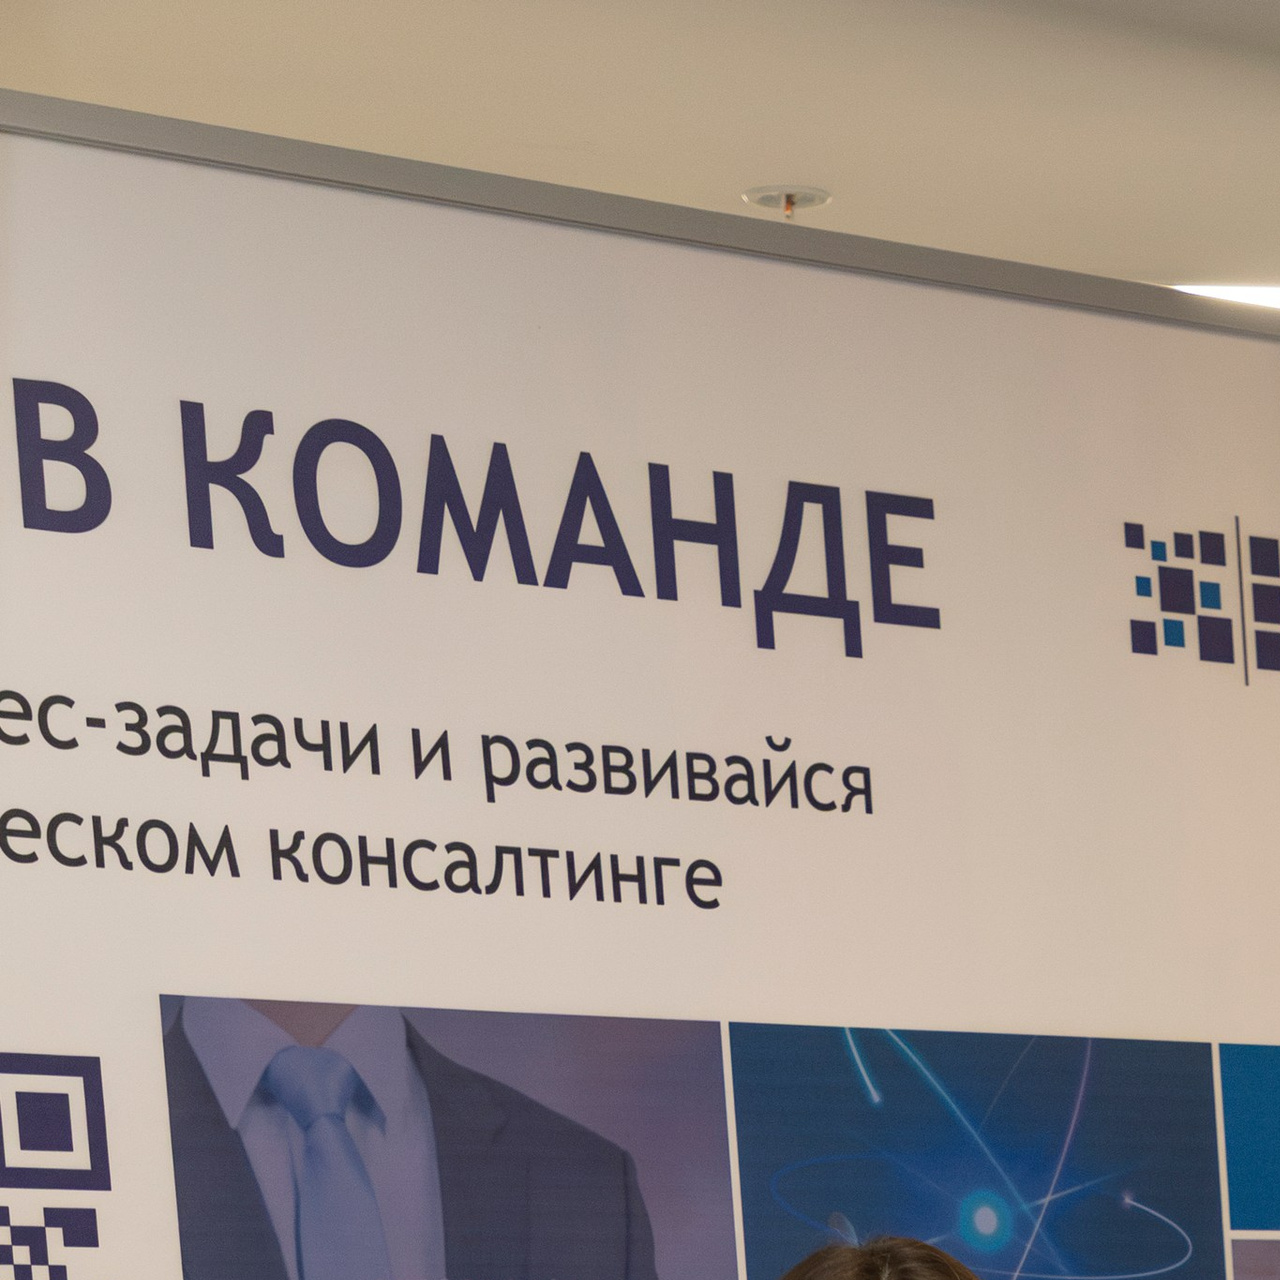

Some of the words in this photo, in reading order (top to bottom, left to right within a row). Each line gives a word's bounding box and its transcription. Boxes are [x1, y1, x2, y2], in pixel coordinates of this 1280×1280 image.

[12, 378, 112, 534] В
[180, 399, 942, 659] КОМАНДЕ
[0, 690, 381, 781] ес-задачи
[412, 728, 452, 782] и
[481, 733, 873, 815] развивайся
[0, 808, 241, 878] еском
[270, 829, 723, 909] консалтинге
